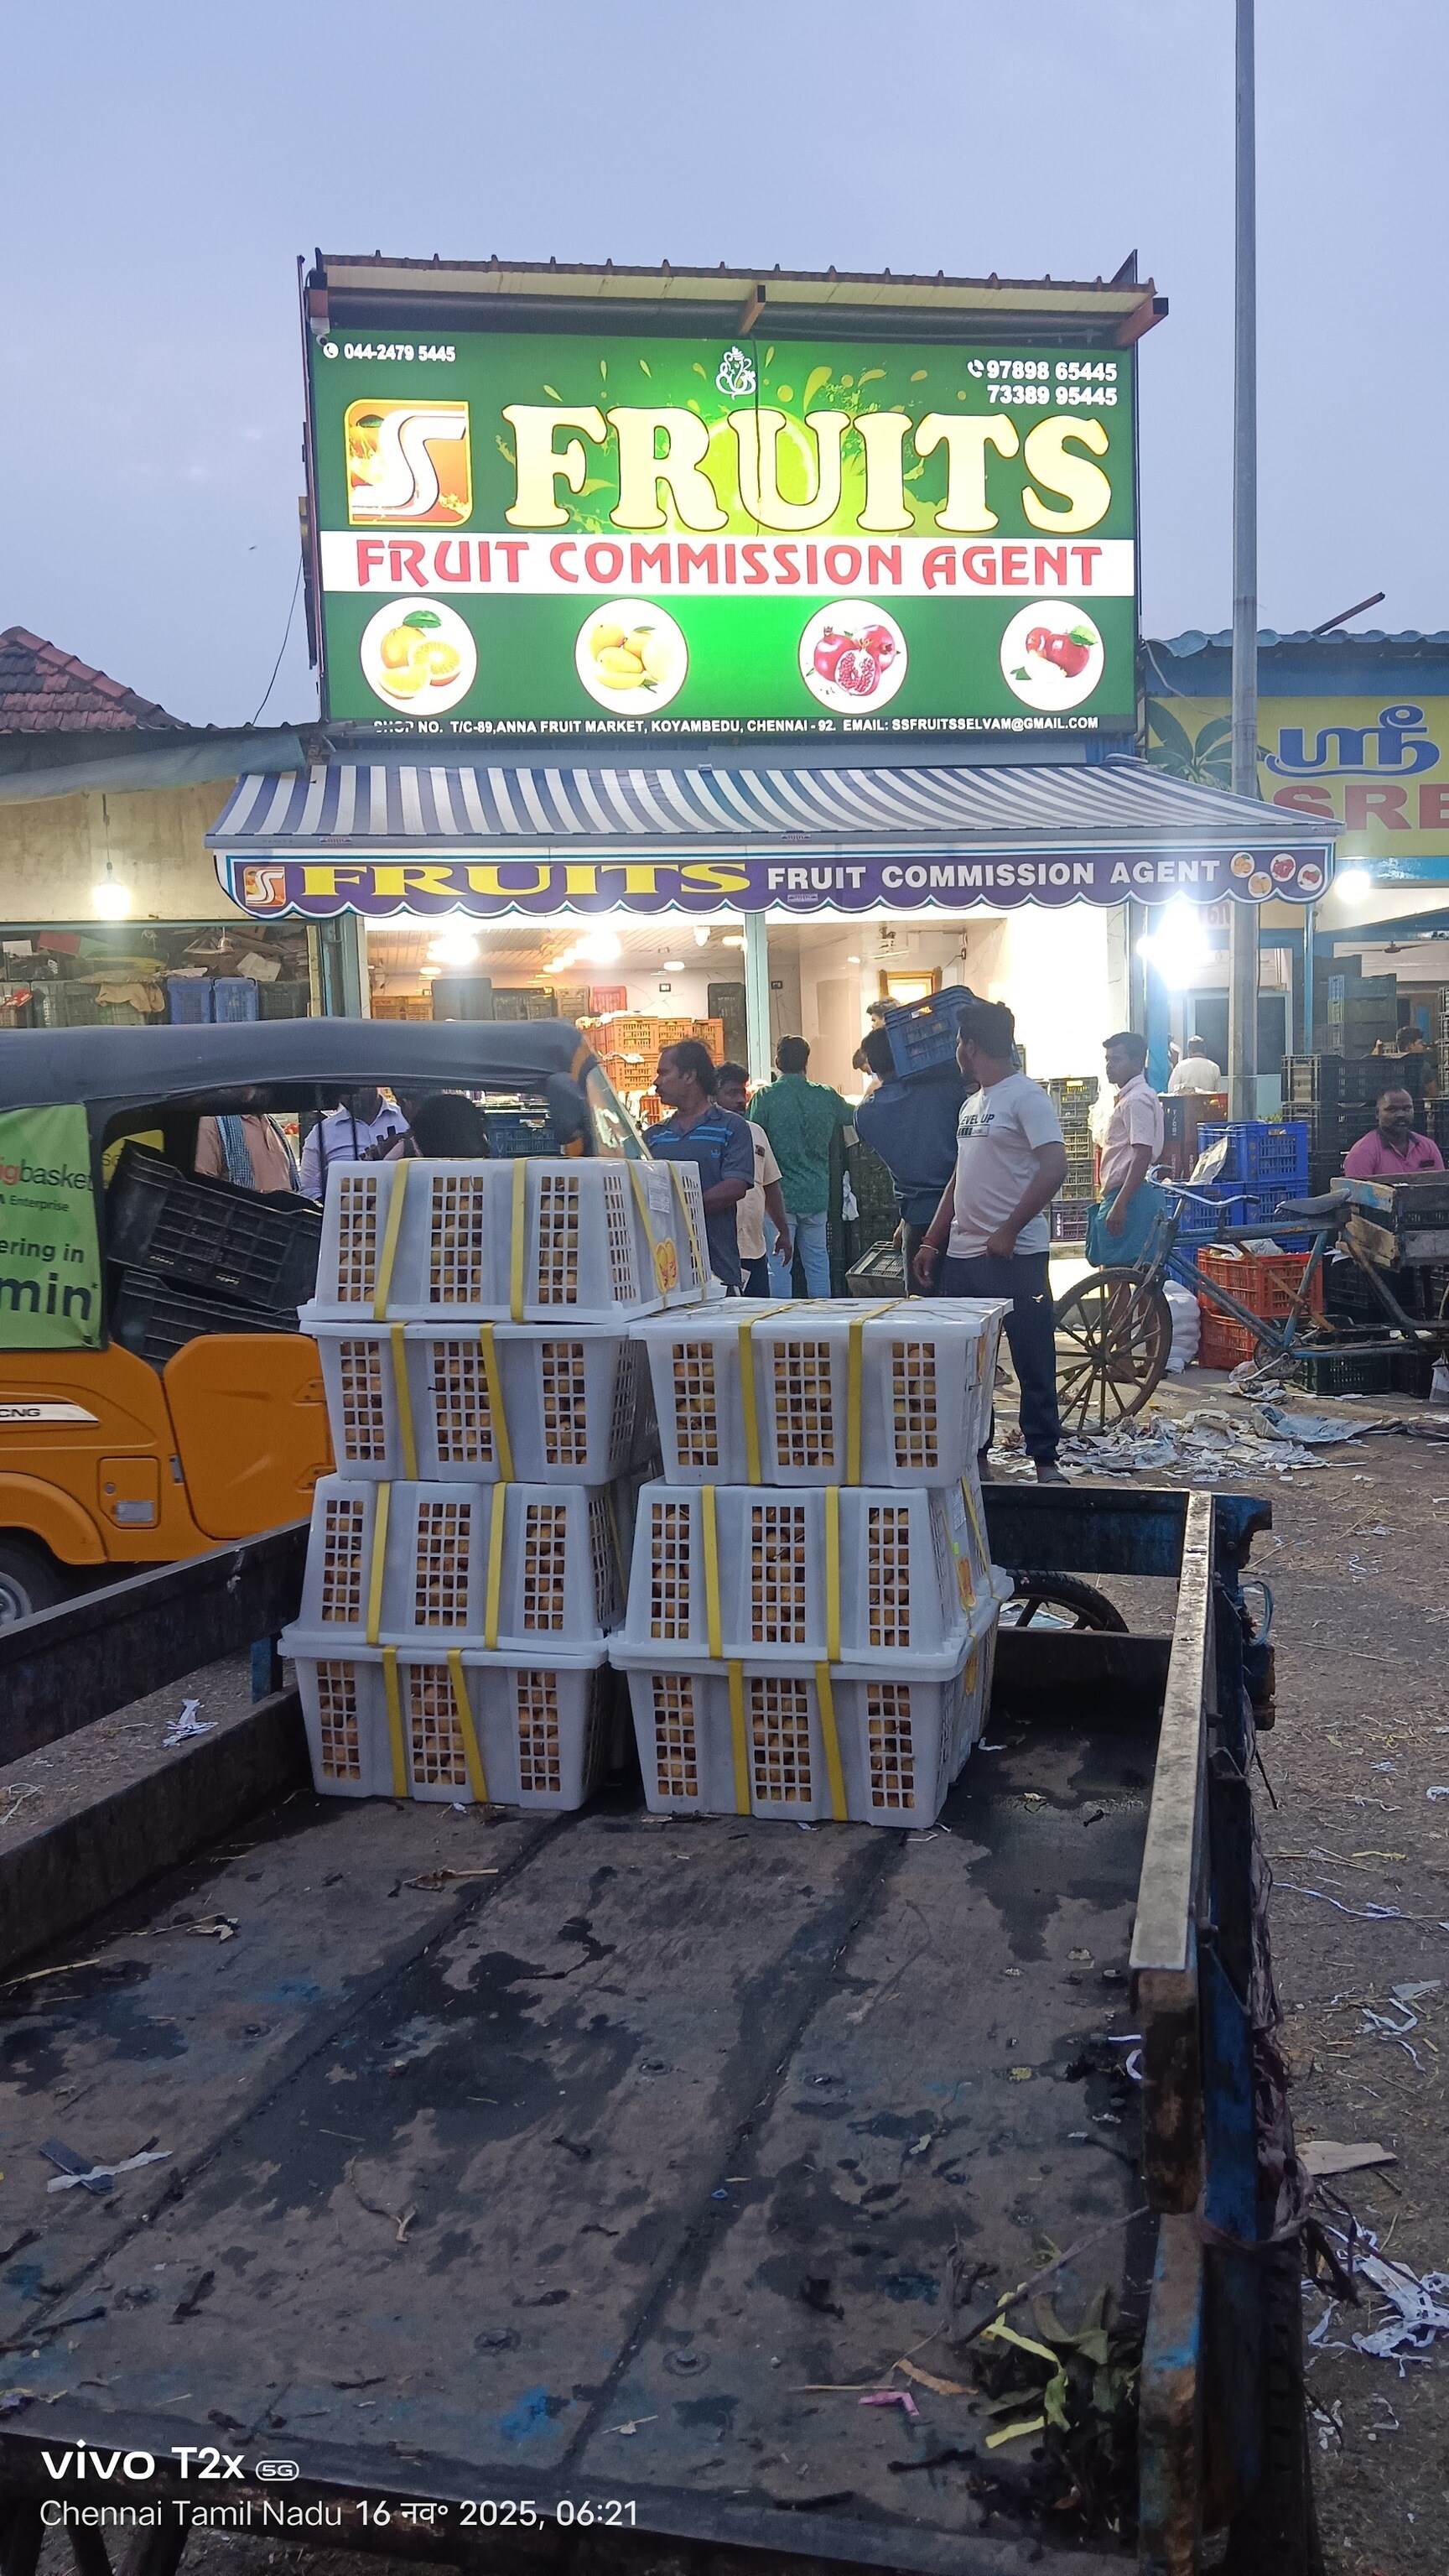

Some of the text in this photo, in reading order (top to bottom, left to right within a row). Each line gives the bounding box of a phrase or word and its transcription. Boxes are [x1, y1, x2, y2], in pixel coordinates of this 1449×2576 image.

[344, 343, 455, 362] 044-2479 5445
[986, 360, 1118, 381] 97898 65445
[987, 384, 1118, 406] 73389 95445
[501, 403, 1112, 534] FRUITS
[356, 539, 1103, 590] FRUIT COMMISSION AGENT
[418, 721, 443, 733] NO.
[541, 721, 581, 732] FRUIT
[585, 720, 647, 734] MARKET,
[652, 720, 744, 733] KOYAMBEDU,
[747, 719, 808, 731] CHENNAI
[818, 719, 836, 731] 92.
[843, 719, 889, 731] EMAIL:
[891, 716, 1098, 731] SSFRUITSSELVAM@GMAIL.COM
[300, 863, 751, 896] FRUITS
[767, 866, 866, 890] FRUIT
[881, 862, 1093, 888] COMMISSION
[1110, 860, 1220, 884] AGENT
[960, 1113, 995, 1125] EVEL UP
[10, 1194, 70, 1212] Enterprise
[63, 1243, 84, 1263] in
